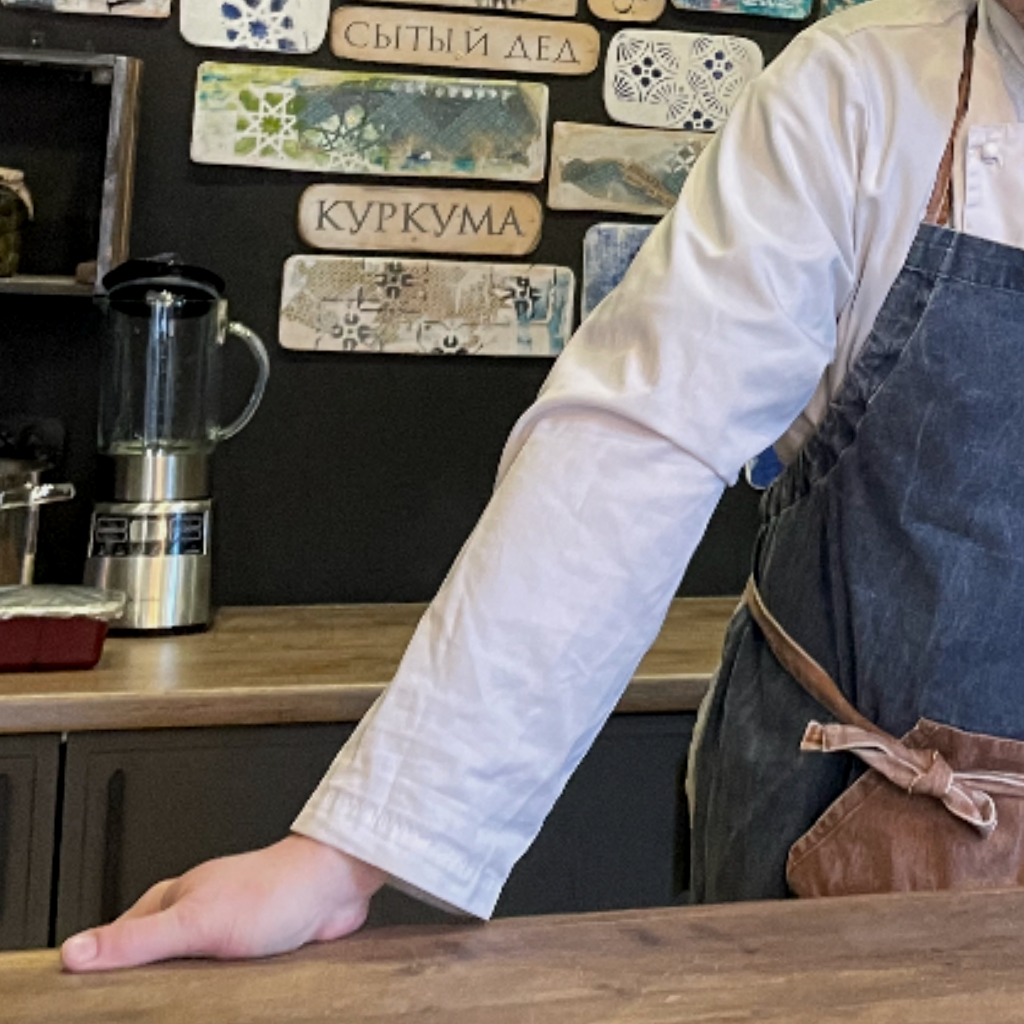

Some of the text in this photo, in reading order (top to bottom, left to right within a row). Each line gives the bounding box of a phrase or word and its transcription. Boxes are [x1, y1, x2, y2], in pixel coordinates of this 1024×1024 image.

[343, 18, 581, 66] СЫТЫЙ ДЕД
[316, 198, 525, 238] КУРКУМА
